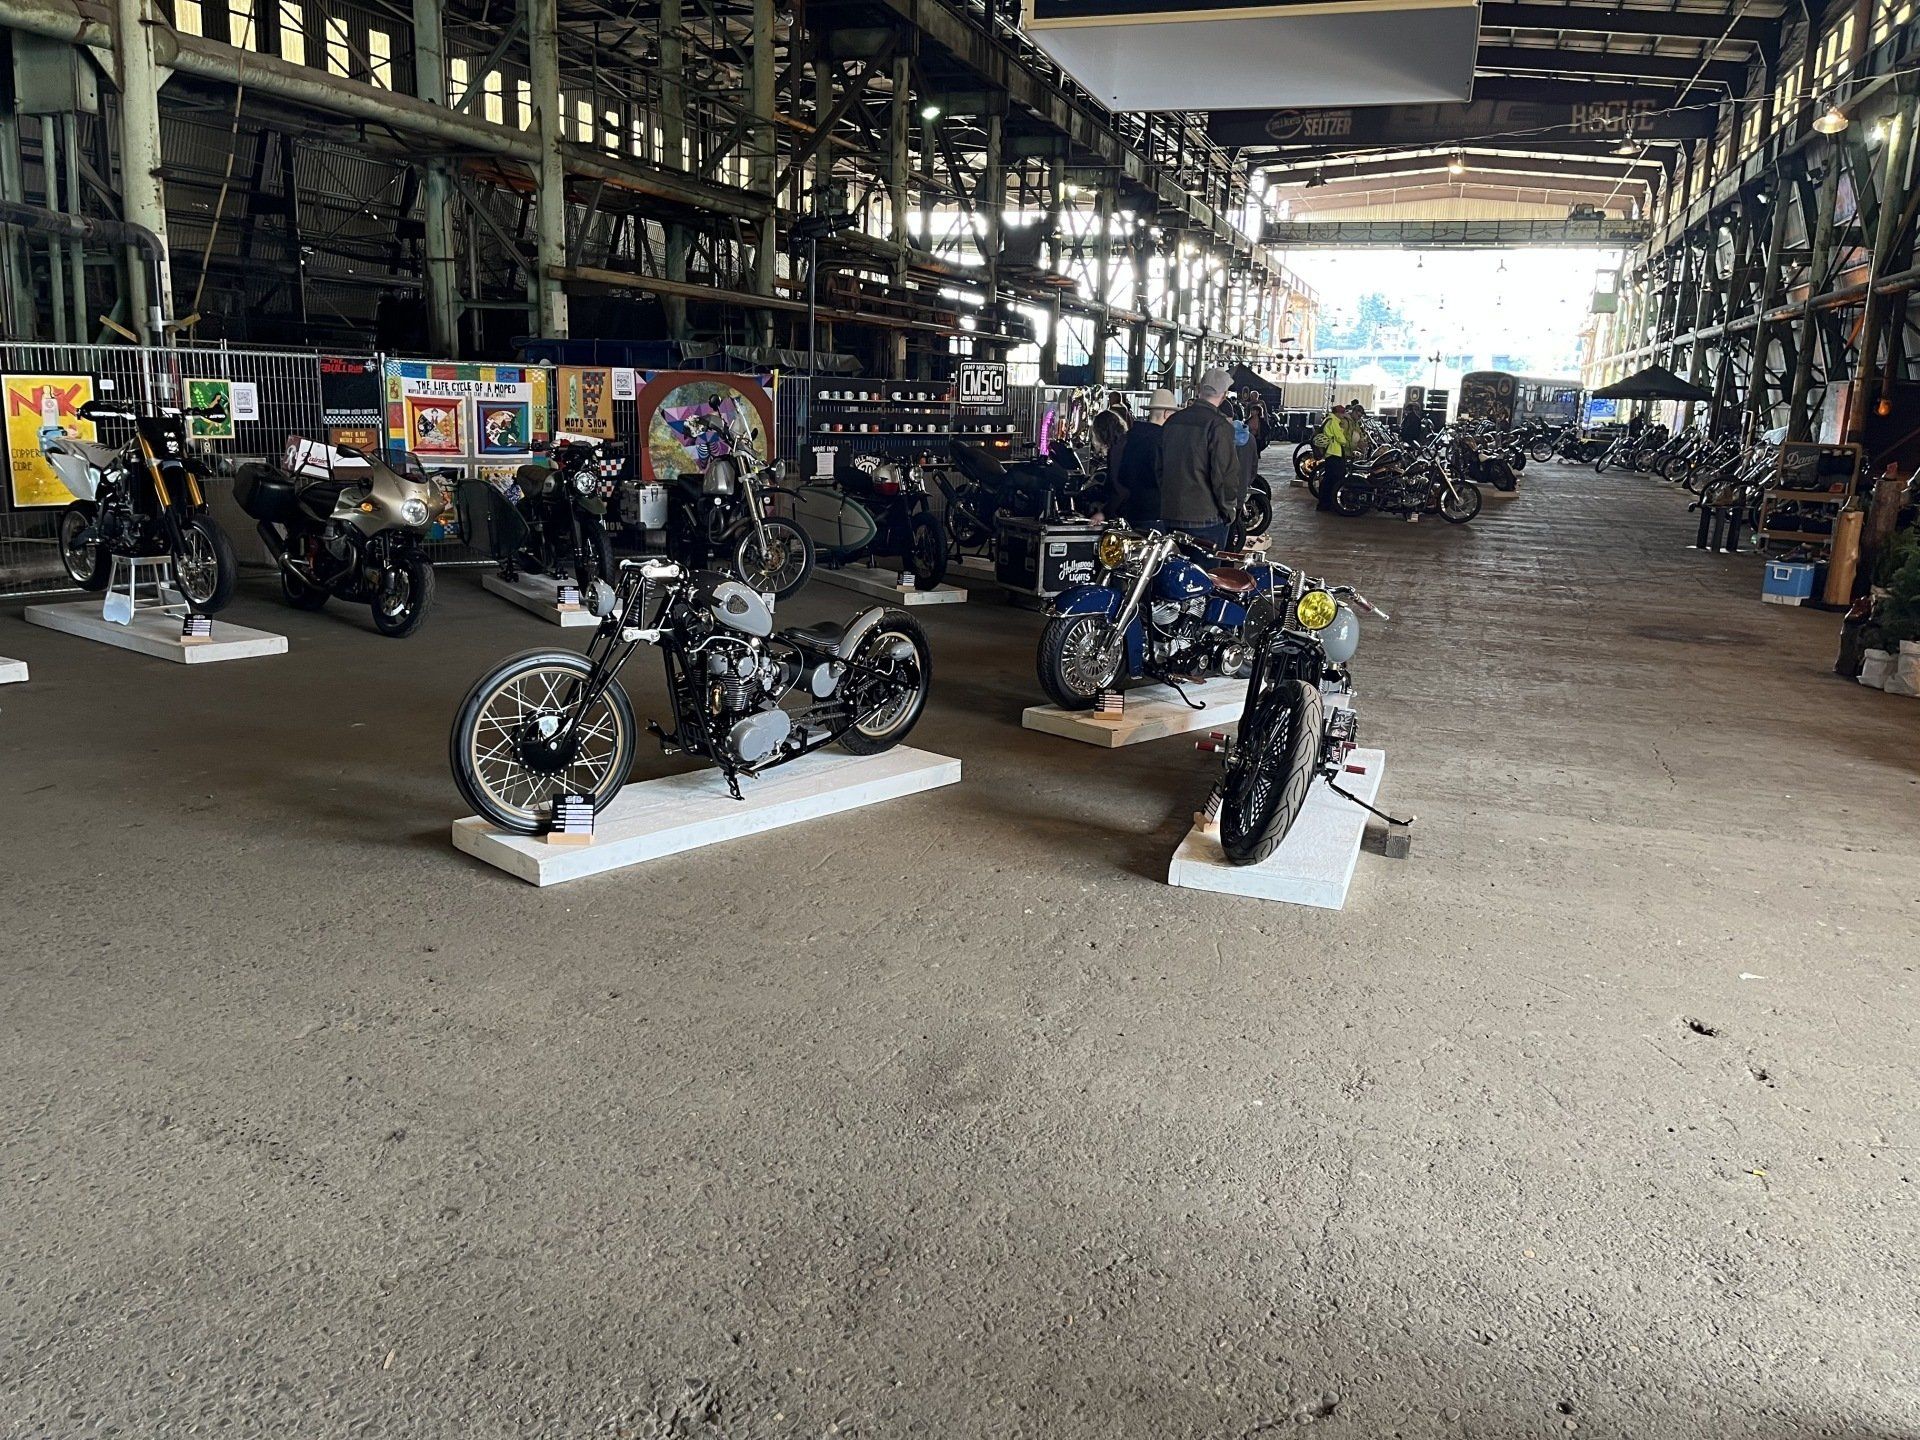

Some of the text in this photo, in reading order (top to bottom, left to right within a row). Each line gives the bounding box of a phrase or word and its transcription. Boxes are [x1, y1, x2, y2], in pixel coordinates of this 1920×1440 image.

[1304, 117, 1352, 136] SELTZER
[416, 380, 517, 394] THE LIFE CYCLE OF A MOPED
[565, 418, 607, 428] MOTO SHOW
[11, 448, 41, 459] COPPER
[812, 445, 839, 453] MORE INFO
[12, 461, 33, 472] CORE
[855, 455, 866, 467] ALL
[1069, 573, 1091, 583] LIGHTS
